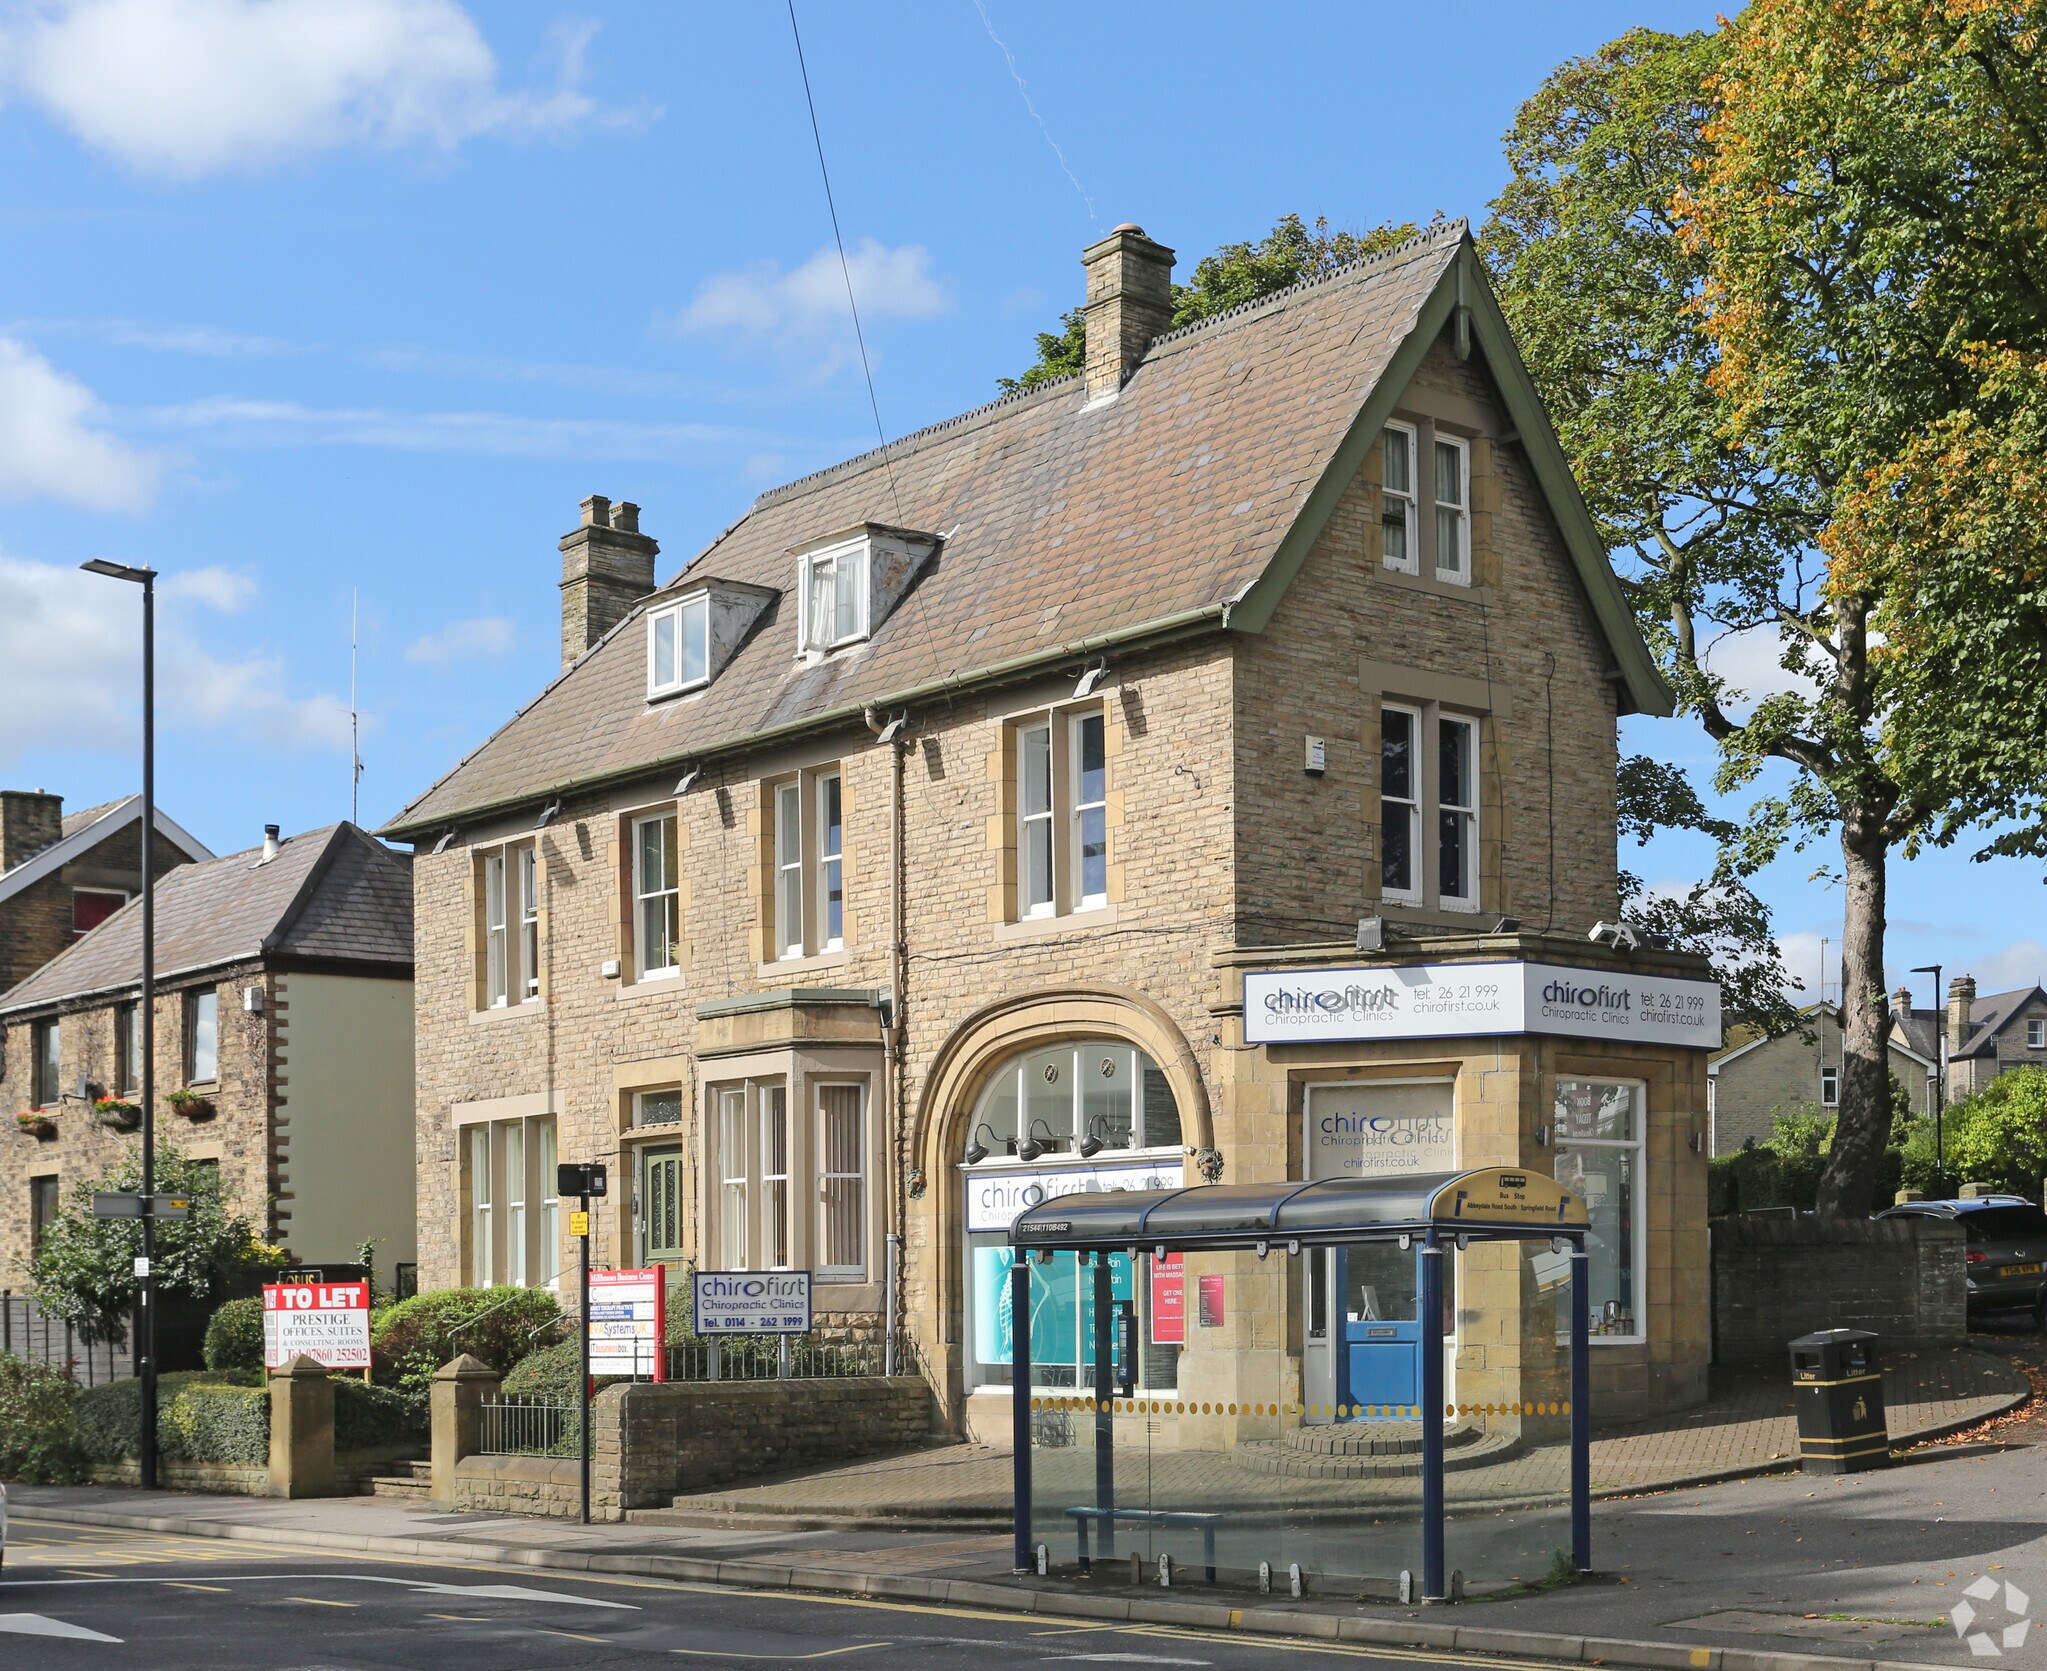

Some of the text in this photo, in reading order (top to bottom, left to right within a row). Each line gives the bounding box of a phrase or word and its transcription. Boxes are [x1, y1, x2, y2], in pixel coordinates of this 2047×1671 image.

[1264, 984, 1395, 1010] chirofirst
[1413, 984, 1499, 1000] tel: 26 21 999
[1543, 980, 1631, 1010] chirofirst
[1413, 999, 1500, 1014] chirofirst.co.uk
[1640, 991, 1704, 1011] tel: 26 21 999
[1264, 1010, 1394, 1025] Chiropractic Clinics
[1541, 1005, 1630, 1025] Chiropractic Clinics
[1640, 1009, 1705, 1026] chirofirst.co.uk
[1321, 1110, 1444, 1133] chirofirst
[1321, 1133, 1445, 1147] Chiropractic Clinics
[1343, 1156, 1420, 1169] chirofirst.co.uk
[1499, 1191, 1526, 1200] Bus Stop
[1466, 1202, 1491, 1211] Abbeydale
[1520, 1204, 1544, 1212] Springfield
[590, 1271, 655, 1282] Millhouses Business Centre
[702, 1276, 805, 1297] chirofirst
[282, 1287, 313, 1309] TO
[319, 1287, 361, 1308] LET
[702, 1298, 805, 1311] Chiropractic Clinics
[292, 1313, 351, 1326] PRESTIGE
[703, 1317, 720, 1328] Tel.
[725, 1317, 746, 1327] 0114
[760, 1317, 778, 1327] 262
[783, 1316, 803, 1326] 1999
[327, 1326, 363, 1336] SUITES
[337, 1338, 364, 1346] ROOMS
[306, 1348, 333, 1361] 07860
[336, 1347, 368, 1361] 252502
[1800, 1372, 1816, 1380] Litter
[1846, 1368, 1866, 1377] Litter
